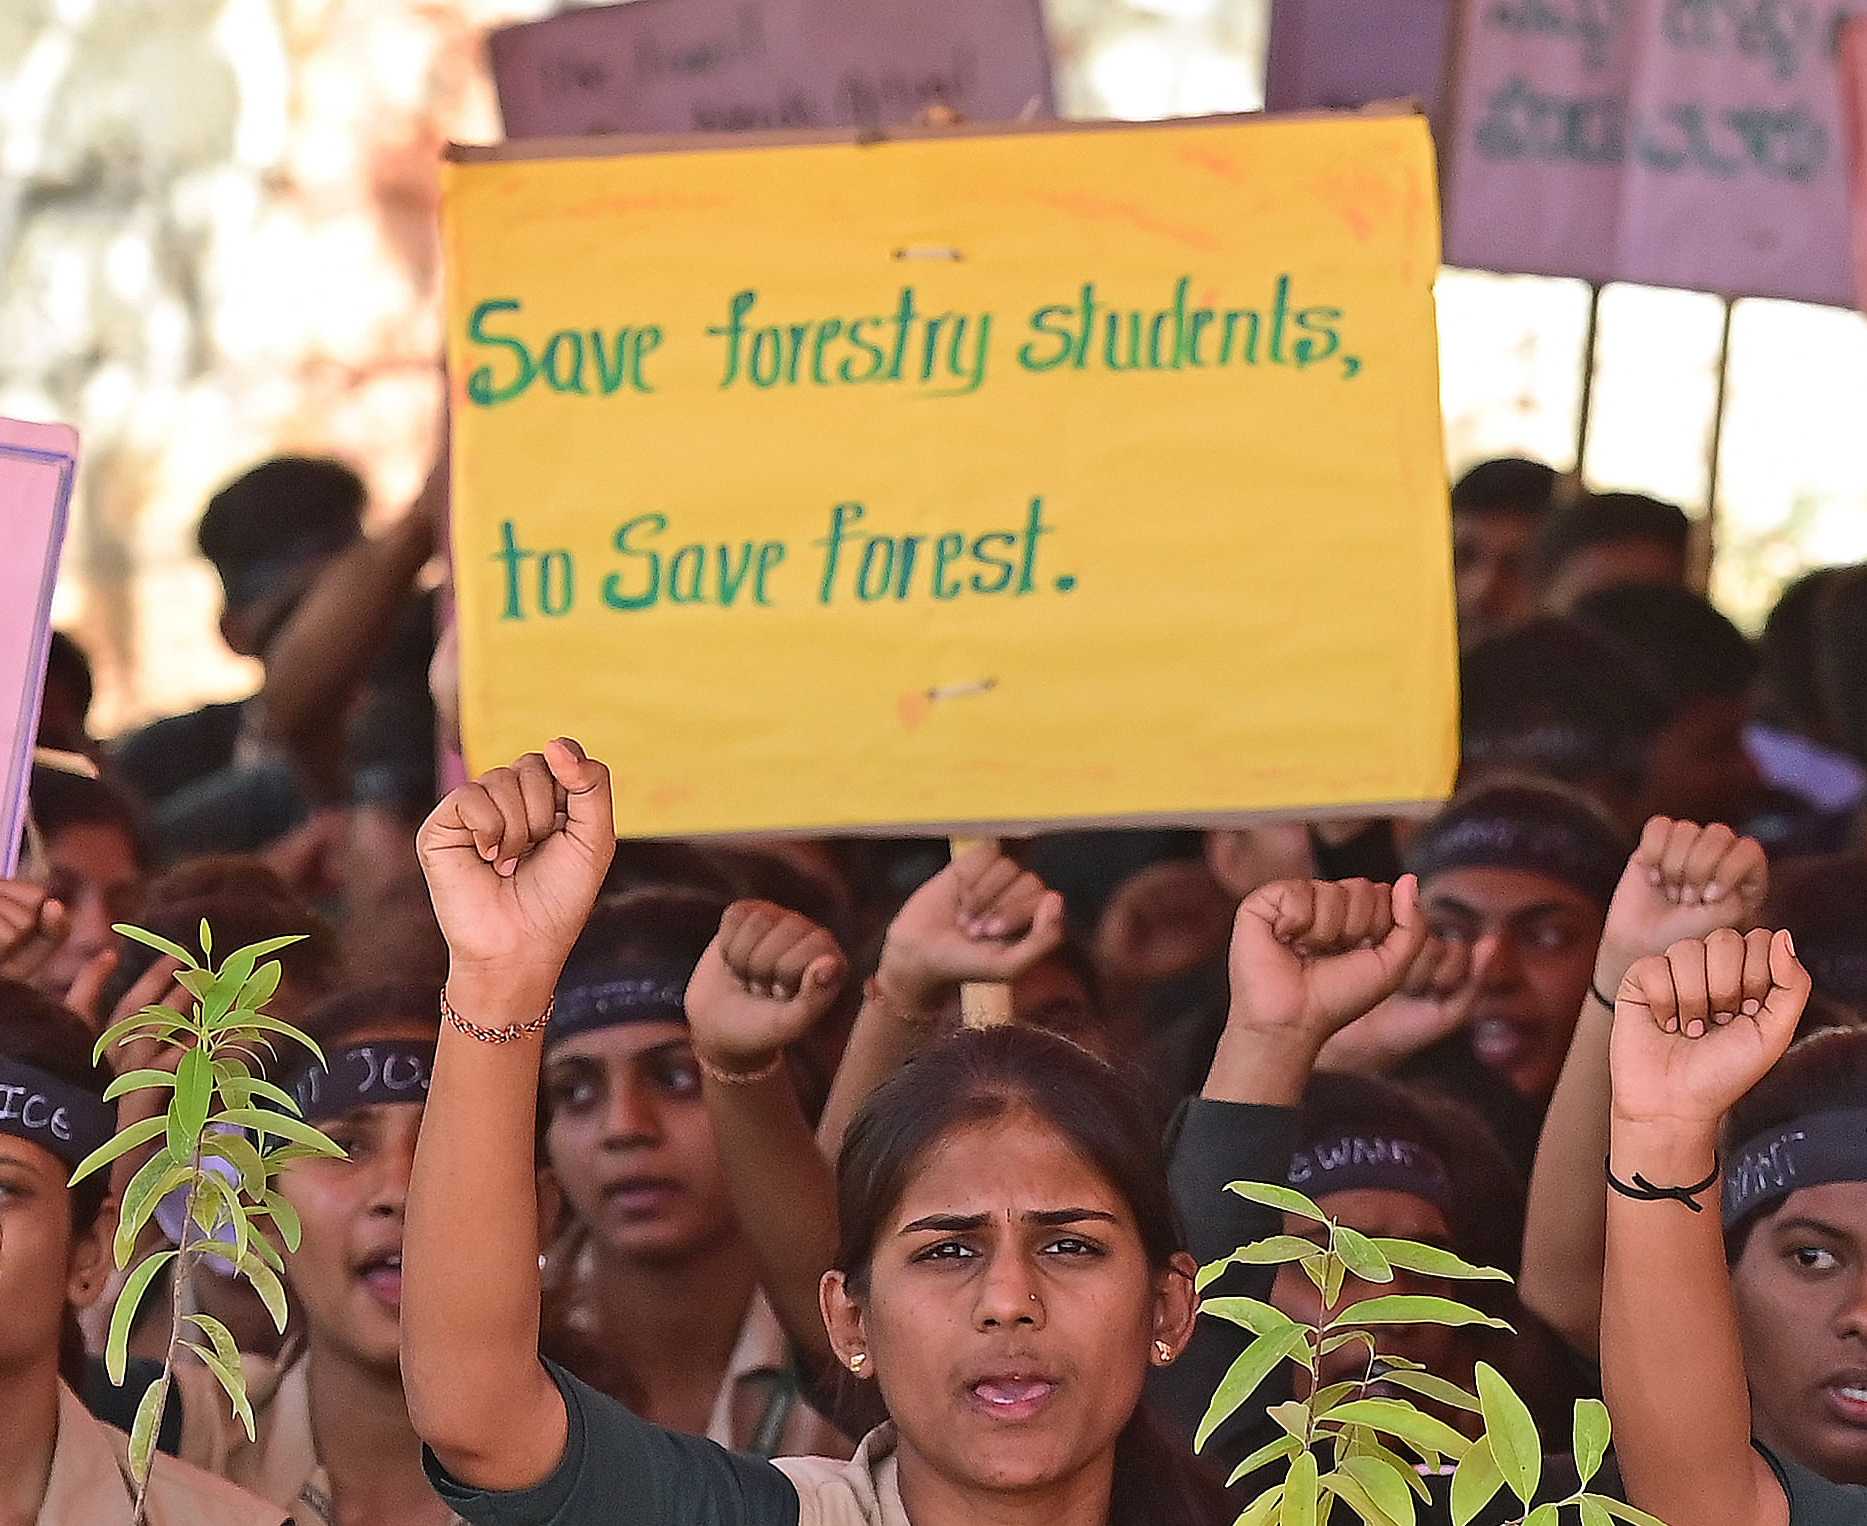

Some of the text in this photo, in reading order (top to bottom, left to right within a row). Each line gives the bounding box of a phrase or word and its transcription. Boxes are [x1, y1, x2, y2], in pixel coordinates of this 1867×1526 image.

[465, 272, 1363, 406] Save forestry students,
[488, 496, 1077, 620] to Save forest.
